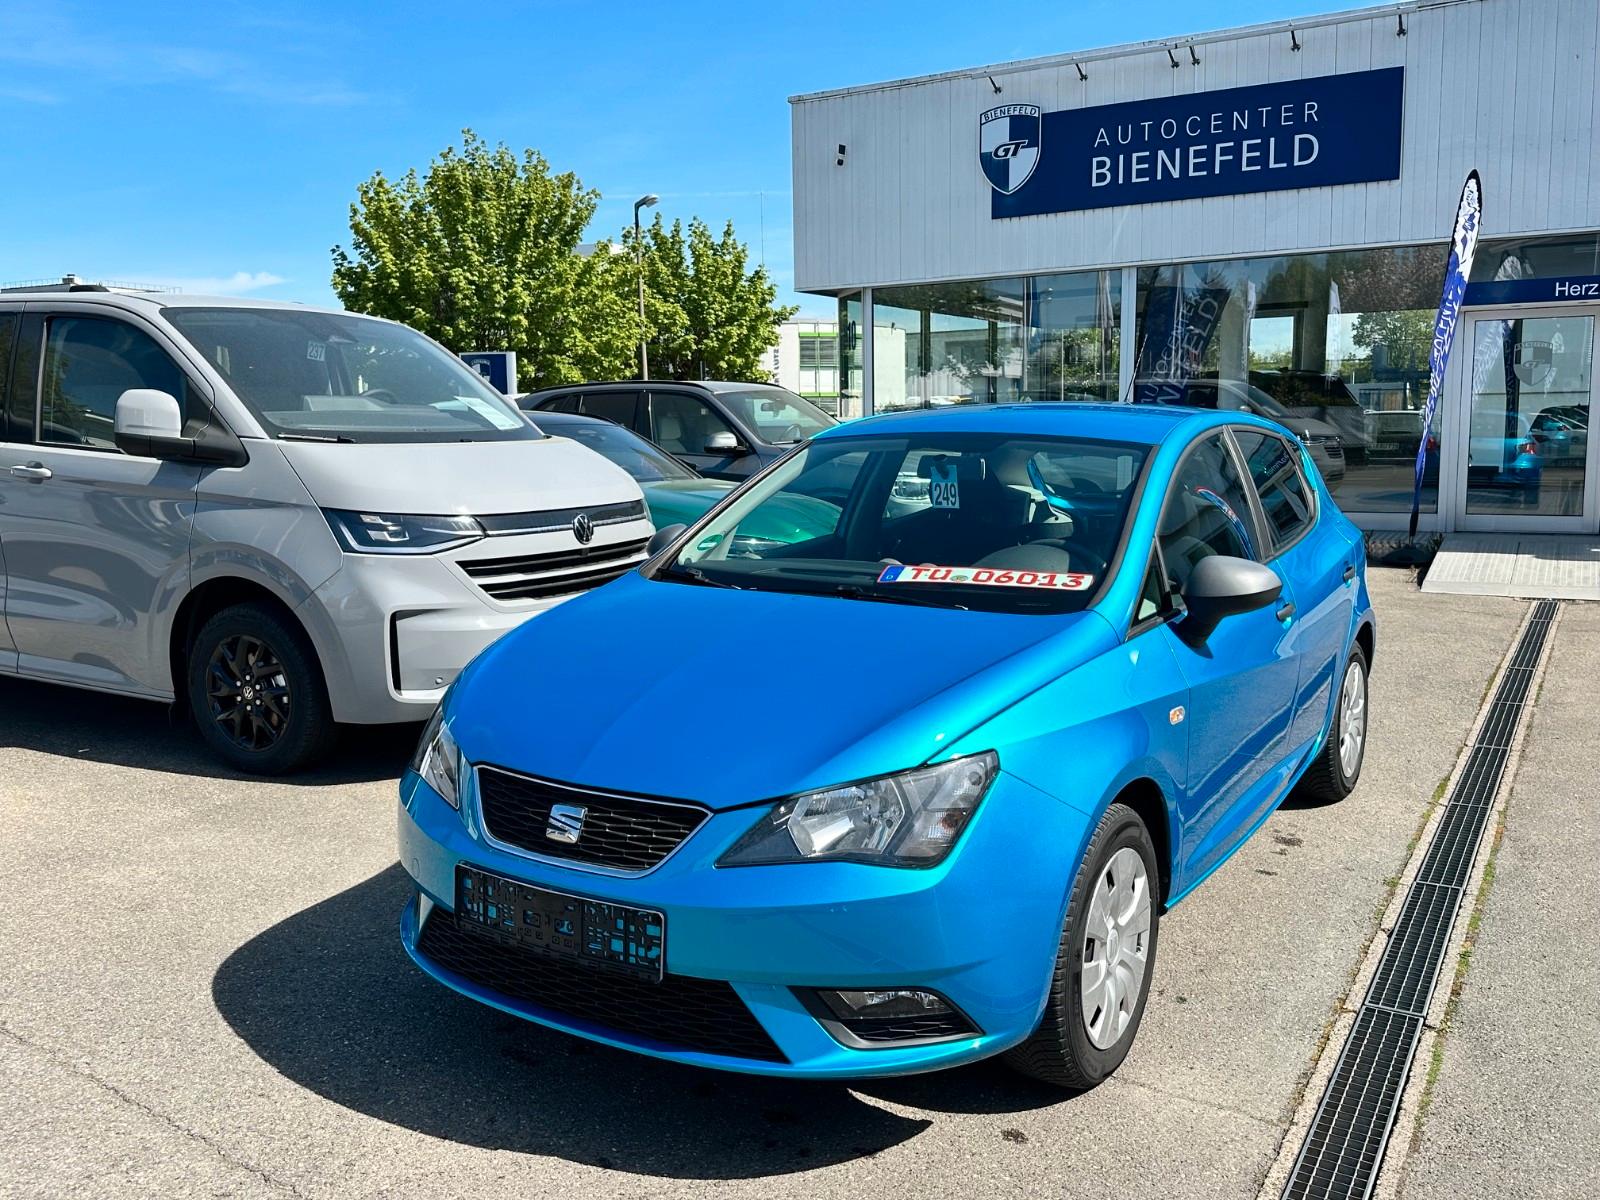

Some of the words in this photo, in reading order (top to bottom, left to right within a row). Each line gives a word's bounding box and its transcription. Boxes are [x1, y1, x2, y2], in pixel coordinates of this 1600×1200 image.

[983, 106, 1037, 121] BIENEFELD
[1094, 101, 1320, 148] AUTOCENTER
[992, 139, 1028, 159] GT
[1091, 133, 1320, 188] BIENEFELD
[1555, 281, 1599, 297] Herz
[308, 343, 325, 359] 237
[934, 480, 958, 507] 249
[971, 570, 1086, 589] 06013
